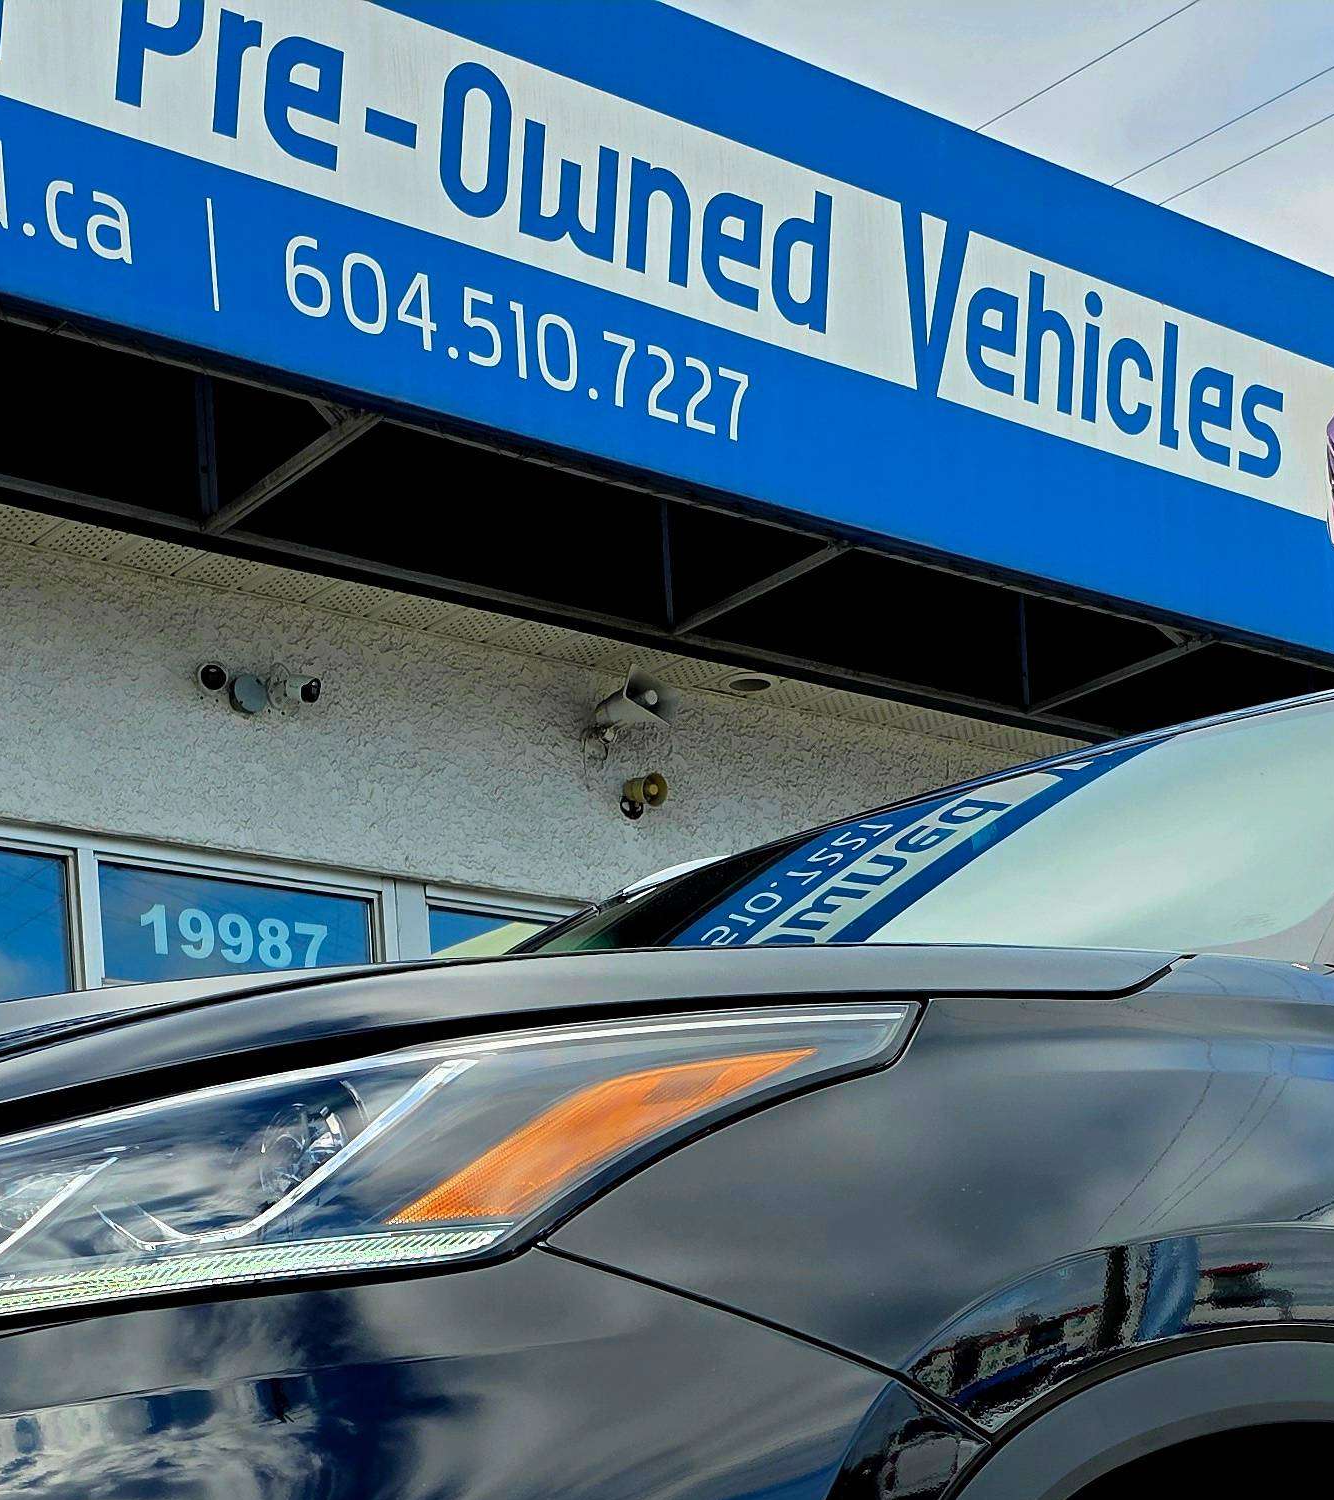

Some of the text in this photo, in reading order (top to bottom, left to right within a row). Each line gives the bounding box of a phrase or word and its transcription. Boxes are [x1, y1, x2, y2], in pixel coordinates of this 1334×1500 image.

[115, 0, 1284, 479] Pre-Owned Vehicles
[283, 235, 750, 442] 604.510.7227
[140, 903, 328, 968] 19987
